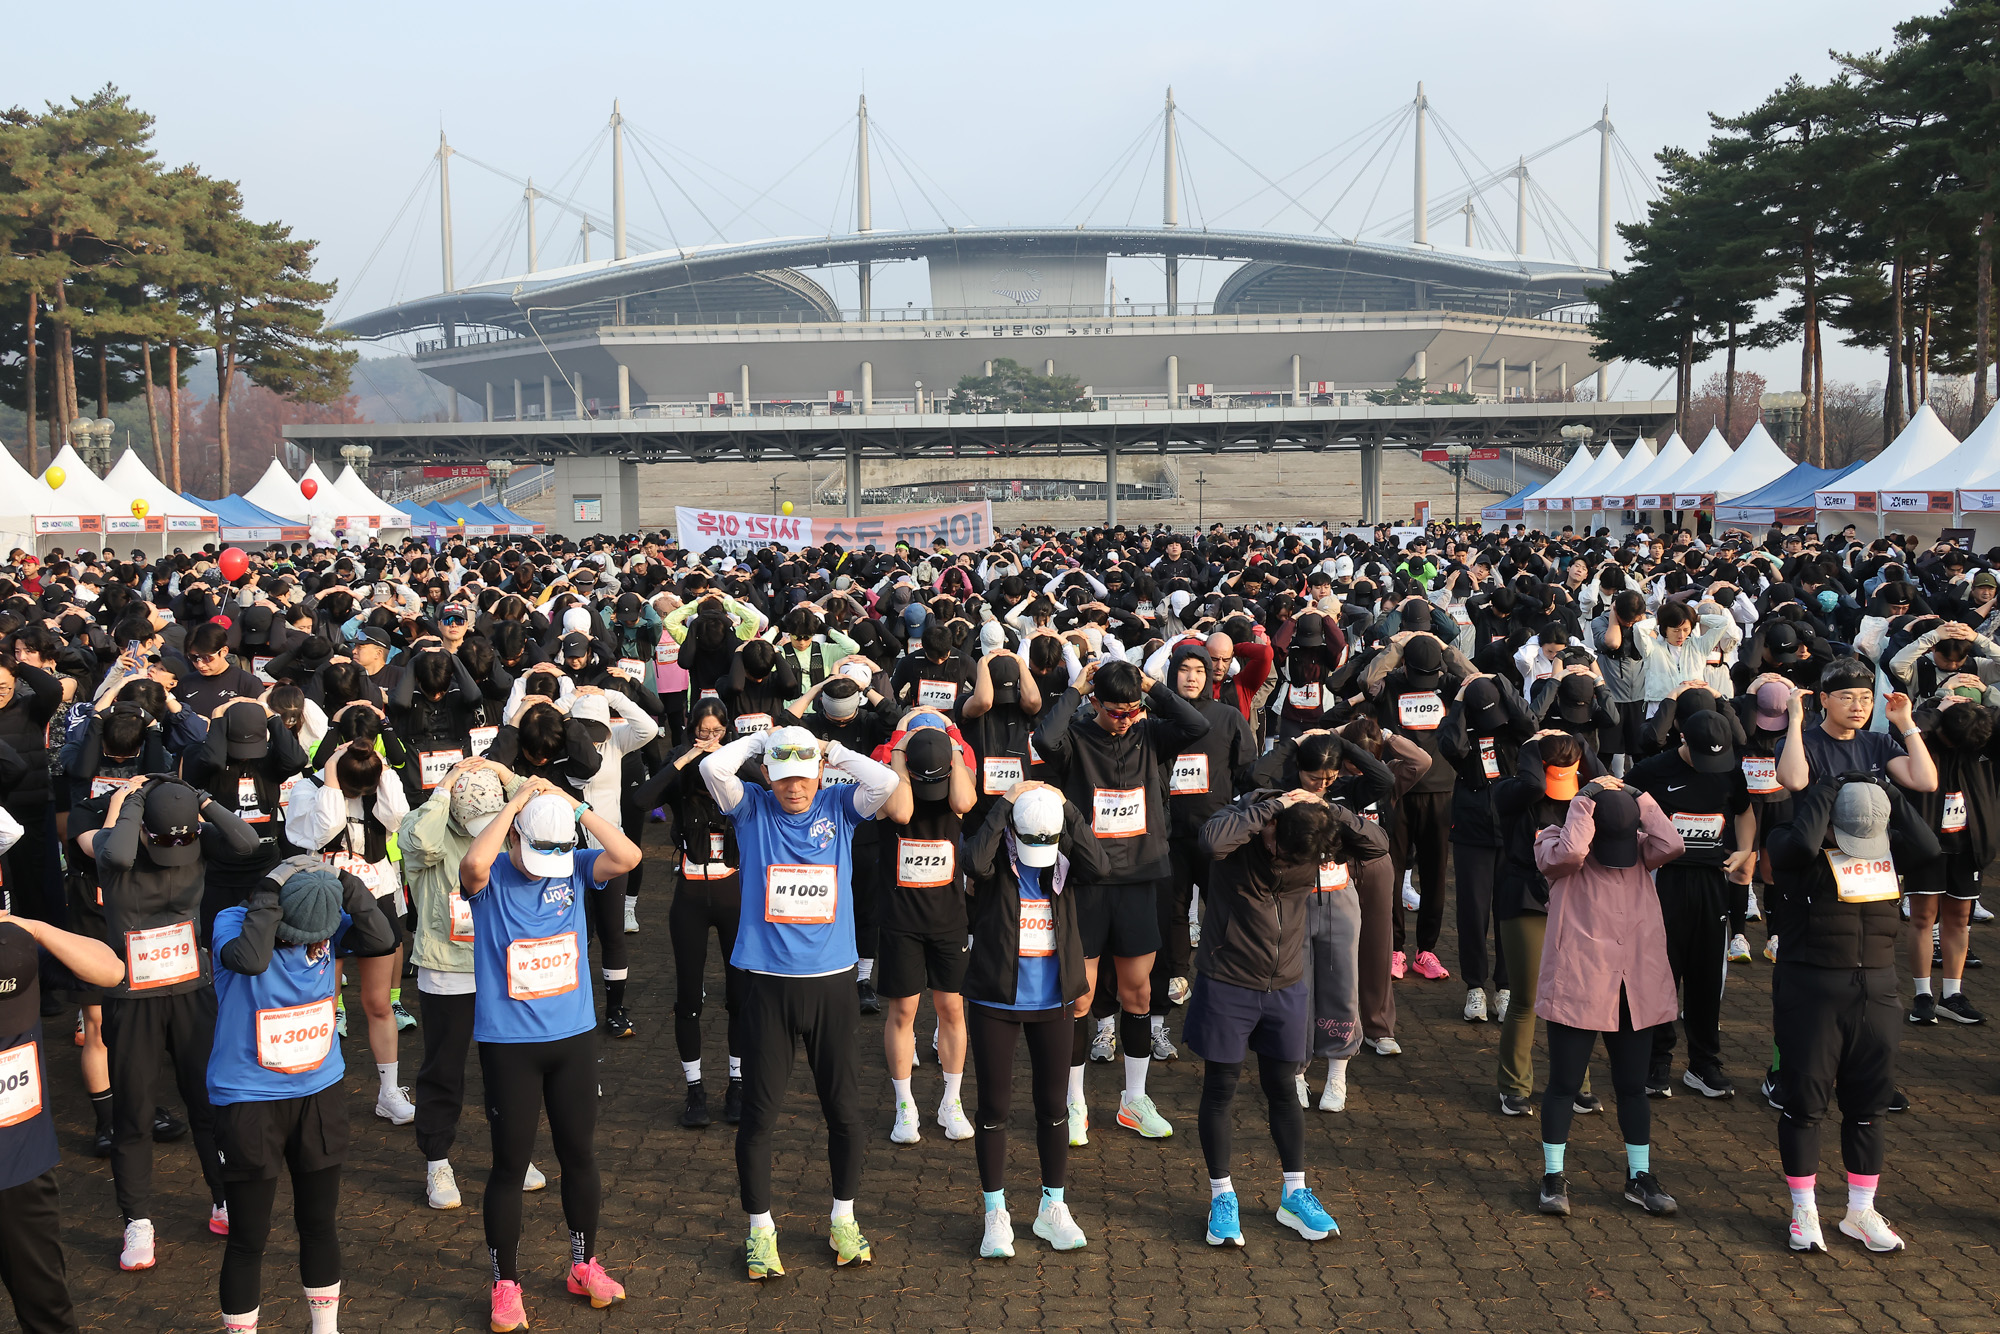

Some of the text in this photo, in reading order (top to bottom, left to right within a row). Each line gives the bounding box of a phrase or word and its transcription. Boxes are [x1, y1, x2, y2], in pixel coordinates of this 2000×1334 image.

[1901, 498, 1918, 506] REXY
[923, 691, 951, 700] M1720
[1405, 704, 1439, 713] M1092
[990, 770, 1020, 779] M2181
[1101, 803, 1140, 817] M1327
[1676, 828, 1717, 838] M1761
[905, 855, 947, 866] M2121
[1842, 860, 1891, 876] W6108
[775, 884, 829, 897] M1009
[1019, 917, 1055, 931] 3005
[138, 943, 190, 961] W3619
[518, 952, 571, 971] W3007
[263, 1012, 292, 1021] BURNING
[305, 1006, 324, 1015] STORY
[270, 1022, 329, 1044] W3006
